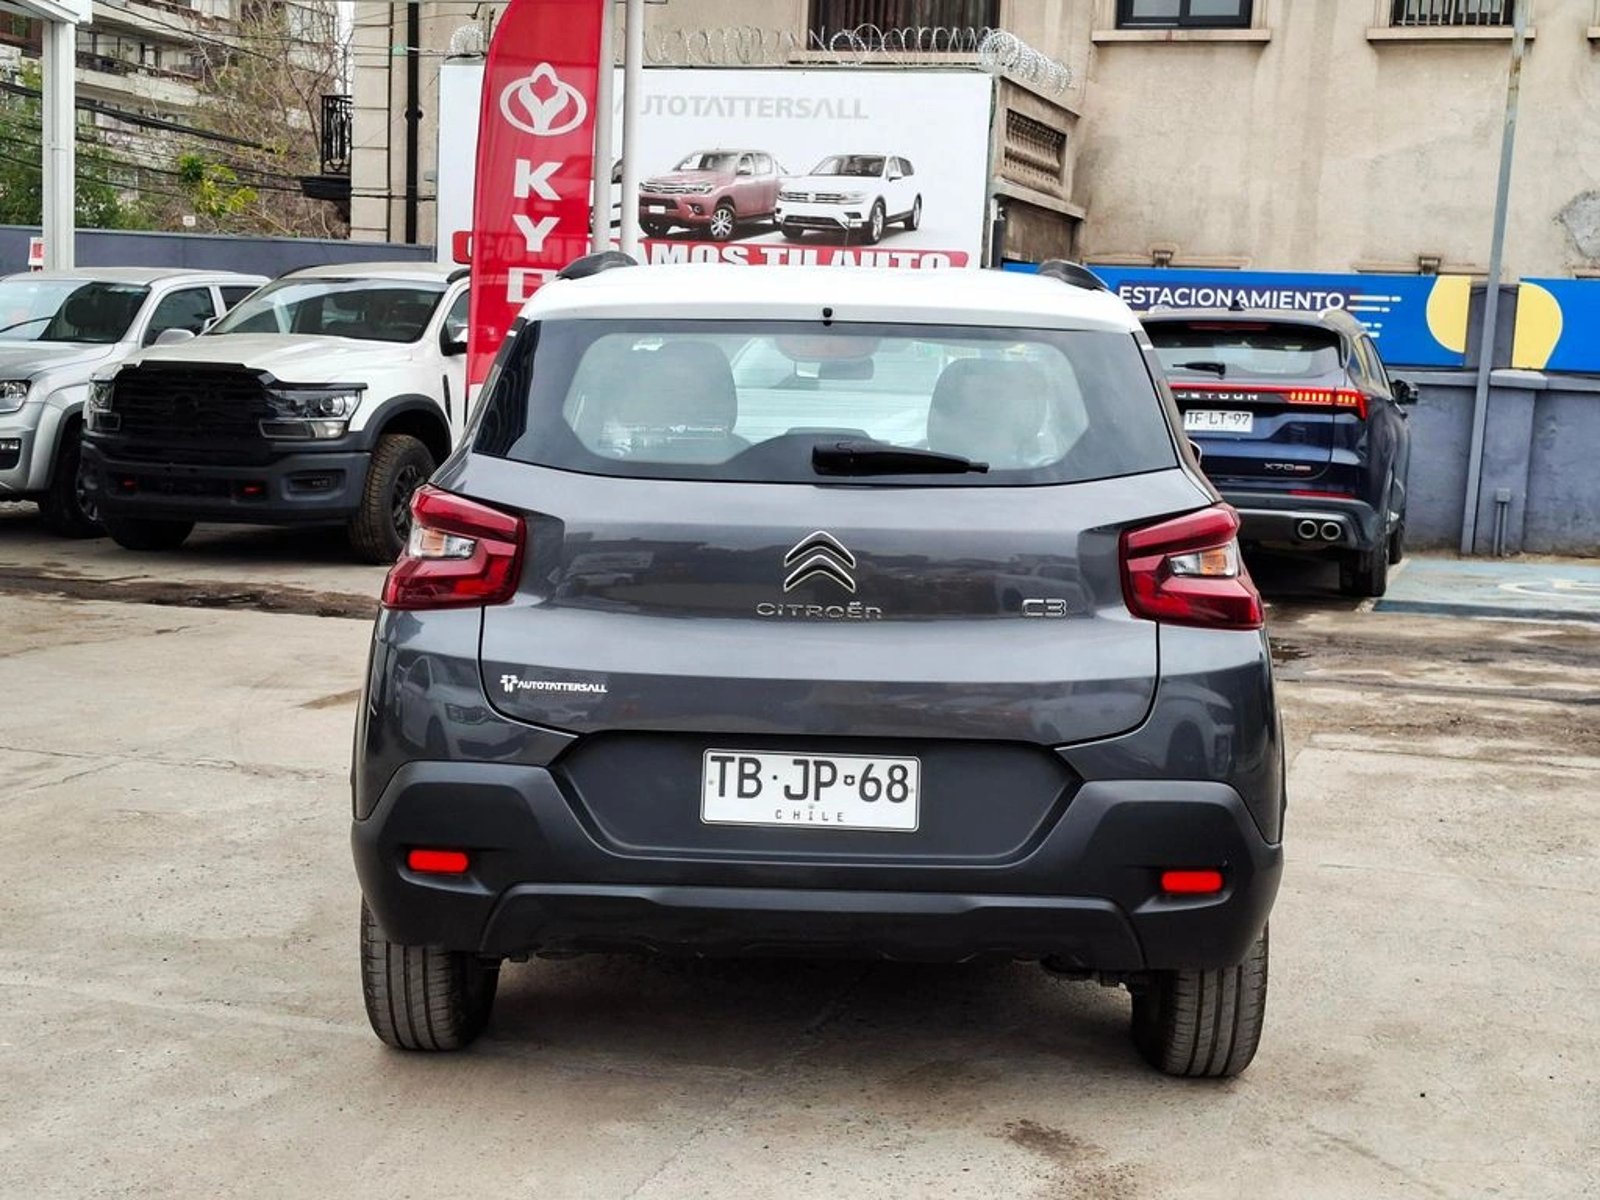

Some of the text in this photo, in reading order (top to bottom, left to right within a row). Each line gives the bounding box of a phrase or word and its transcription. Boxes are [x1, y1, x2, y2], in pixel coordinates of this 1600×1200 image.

[613, 95, 869, 119] UTOTATTERSALL
[1118, 286, 1345, 310] ESTACIONAMIENTO
[756, 601, 882, 619] CITROËN
[1022, 599, 1067, 617] C3
[517, 680, 608, 693] AUTOTATTERSALL
[775, 808, 844, 823] CHILE
